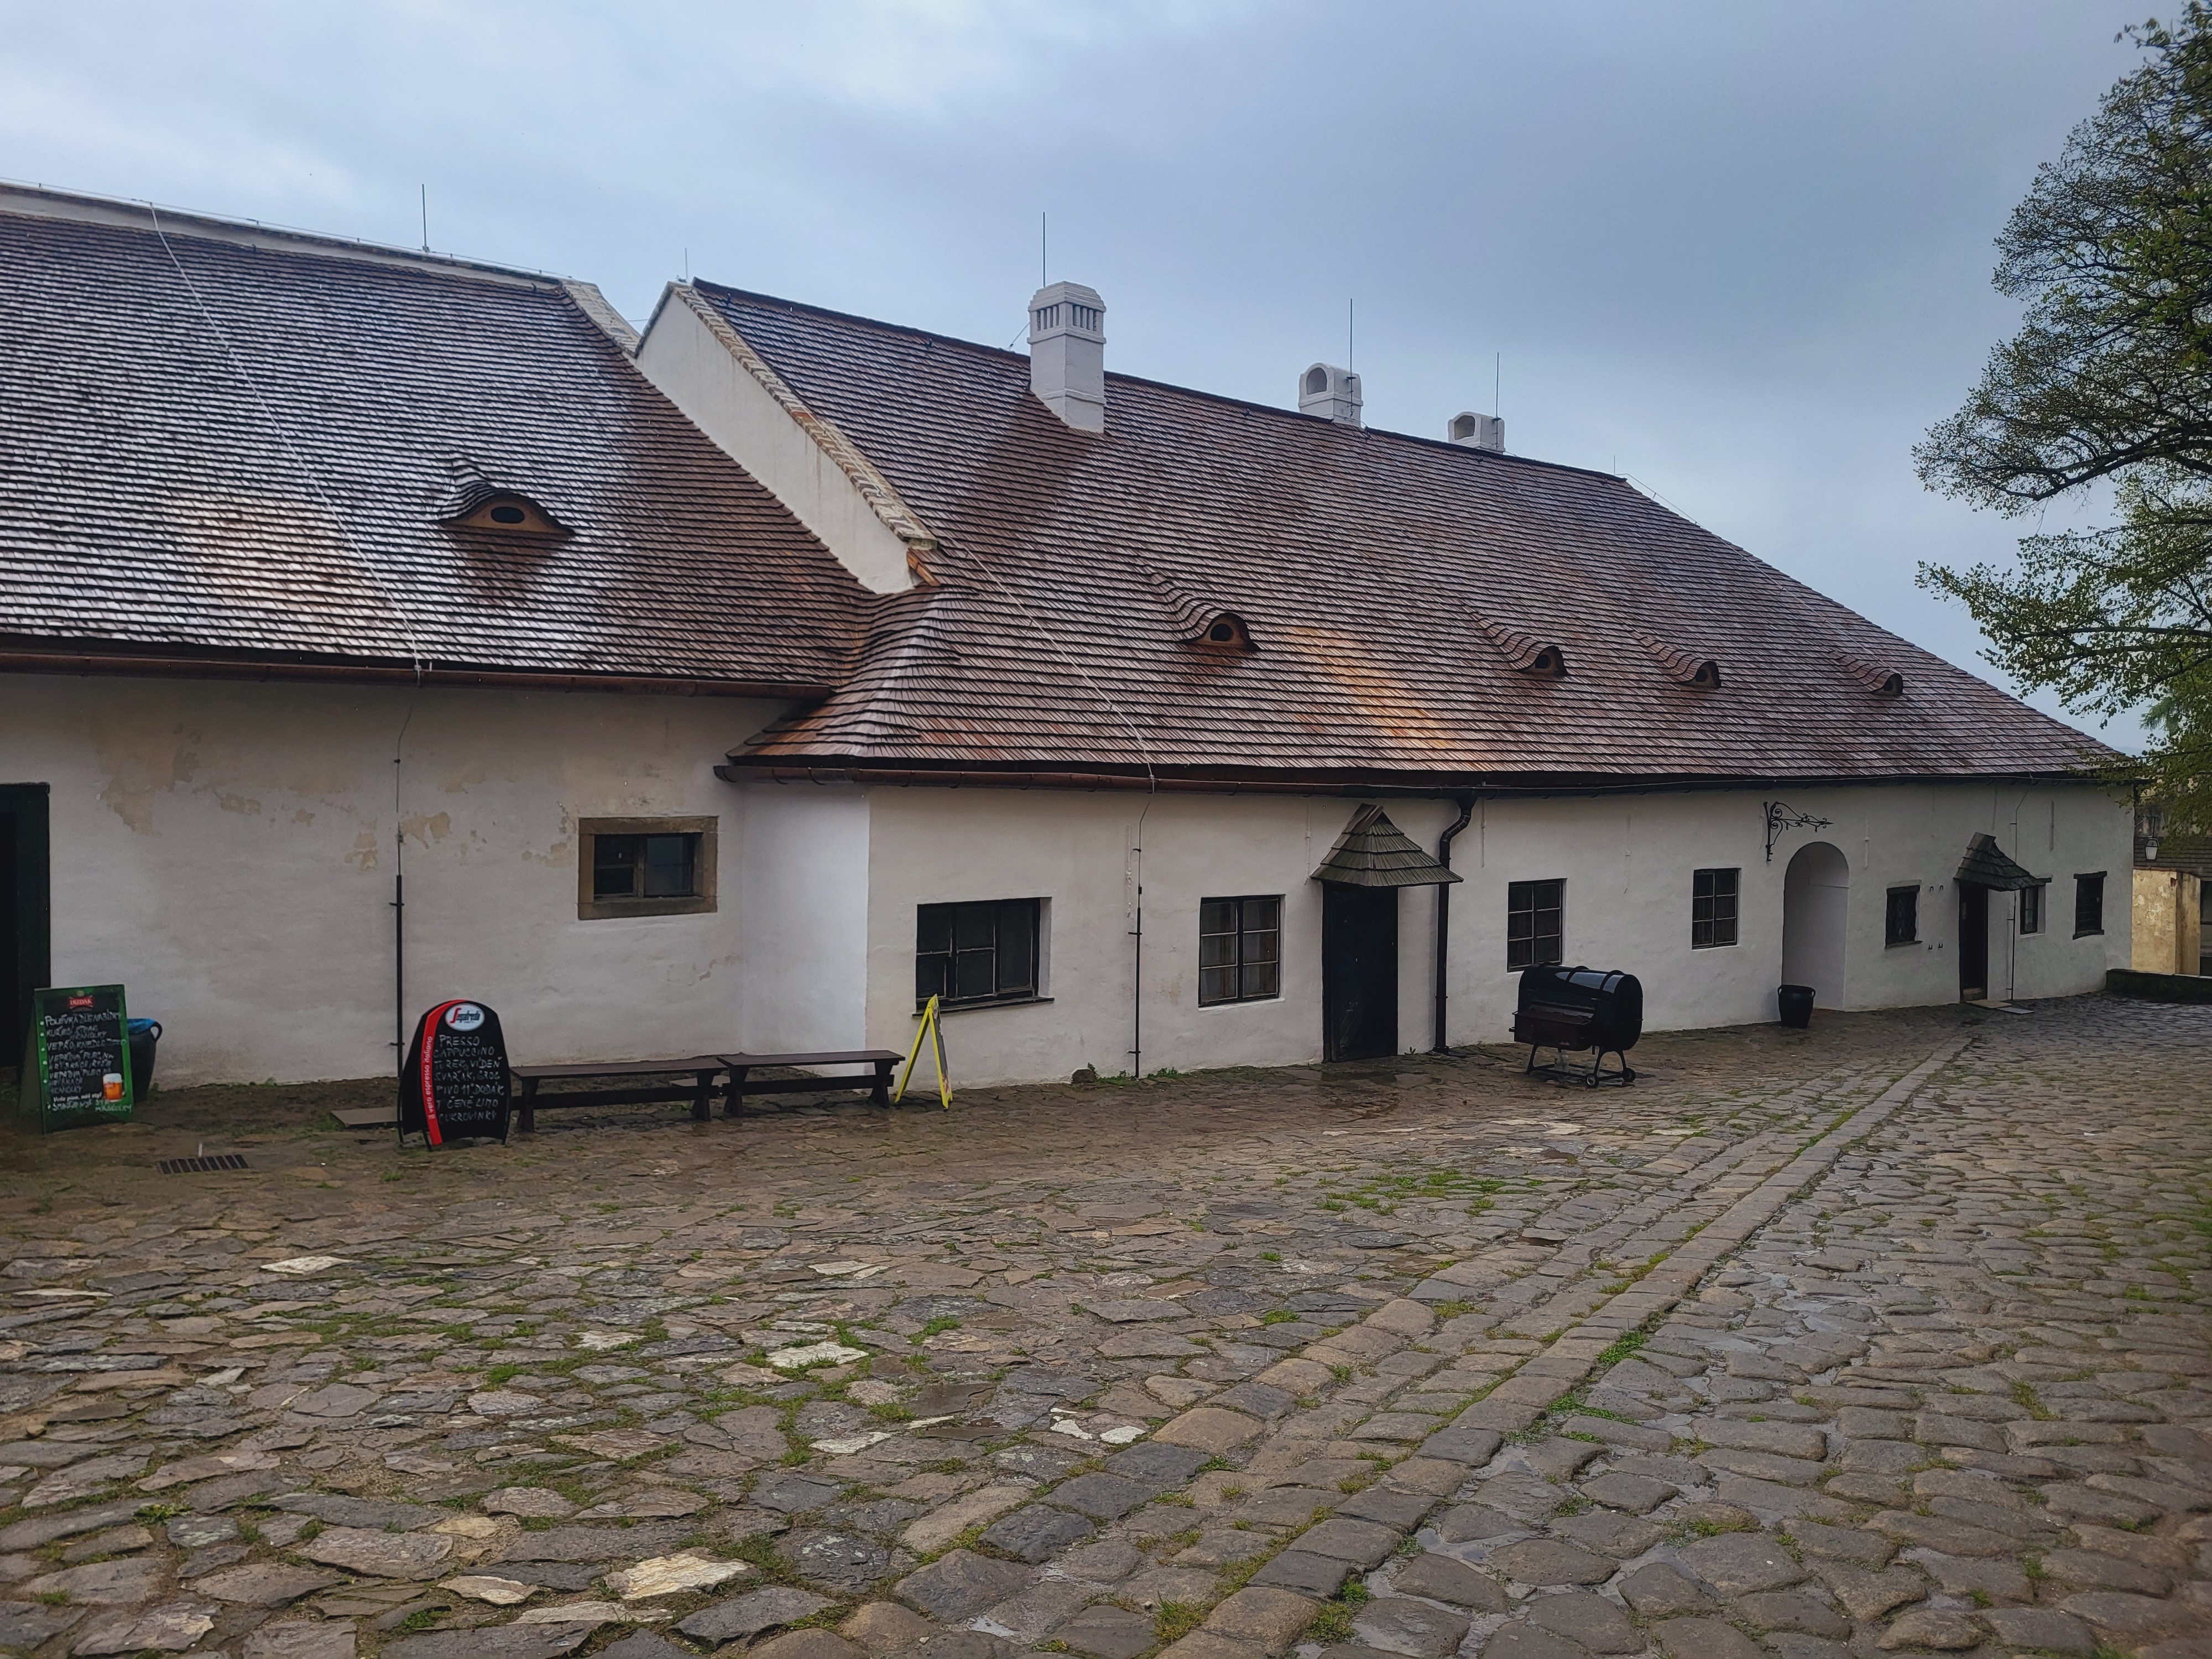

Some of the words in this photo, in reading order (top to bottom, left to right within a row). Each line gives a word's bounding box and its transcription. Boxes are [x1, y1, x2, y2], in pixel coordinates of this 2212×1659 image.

[439, 1034, 480, 1047] PRESSO
[433, 1046, 495, 1058] CAPPUCCINO
[436, 1084, 459, 1095] PIVO
[476, 1098, 498, 1109] LIMO
[439, 1110, 497, 1123] CUKROVINKY
